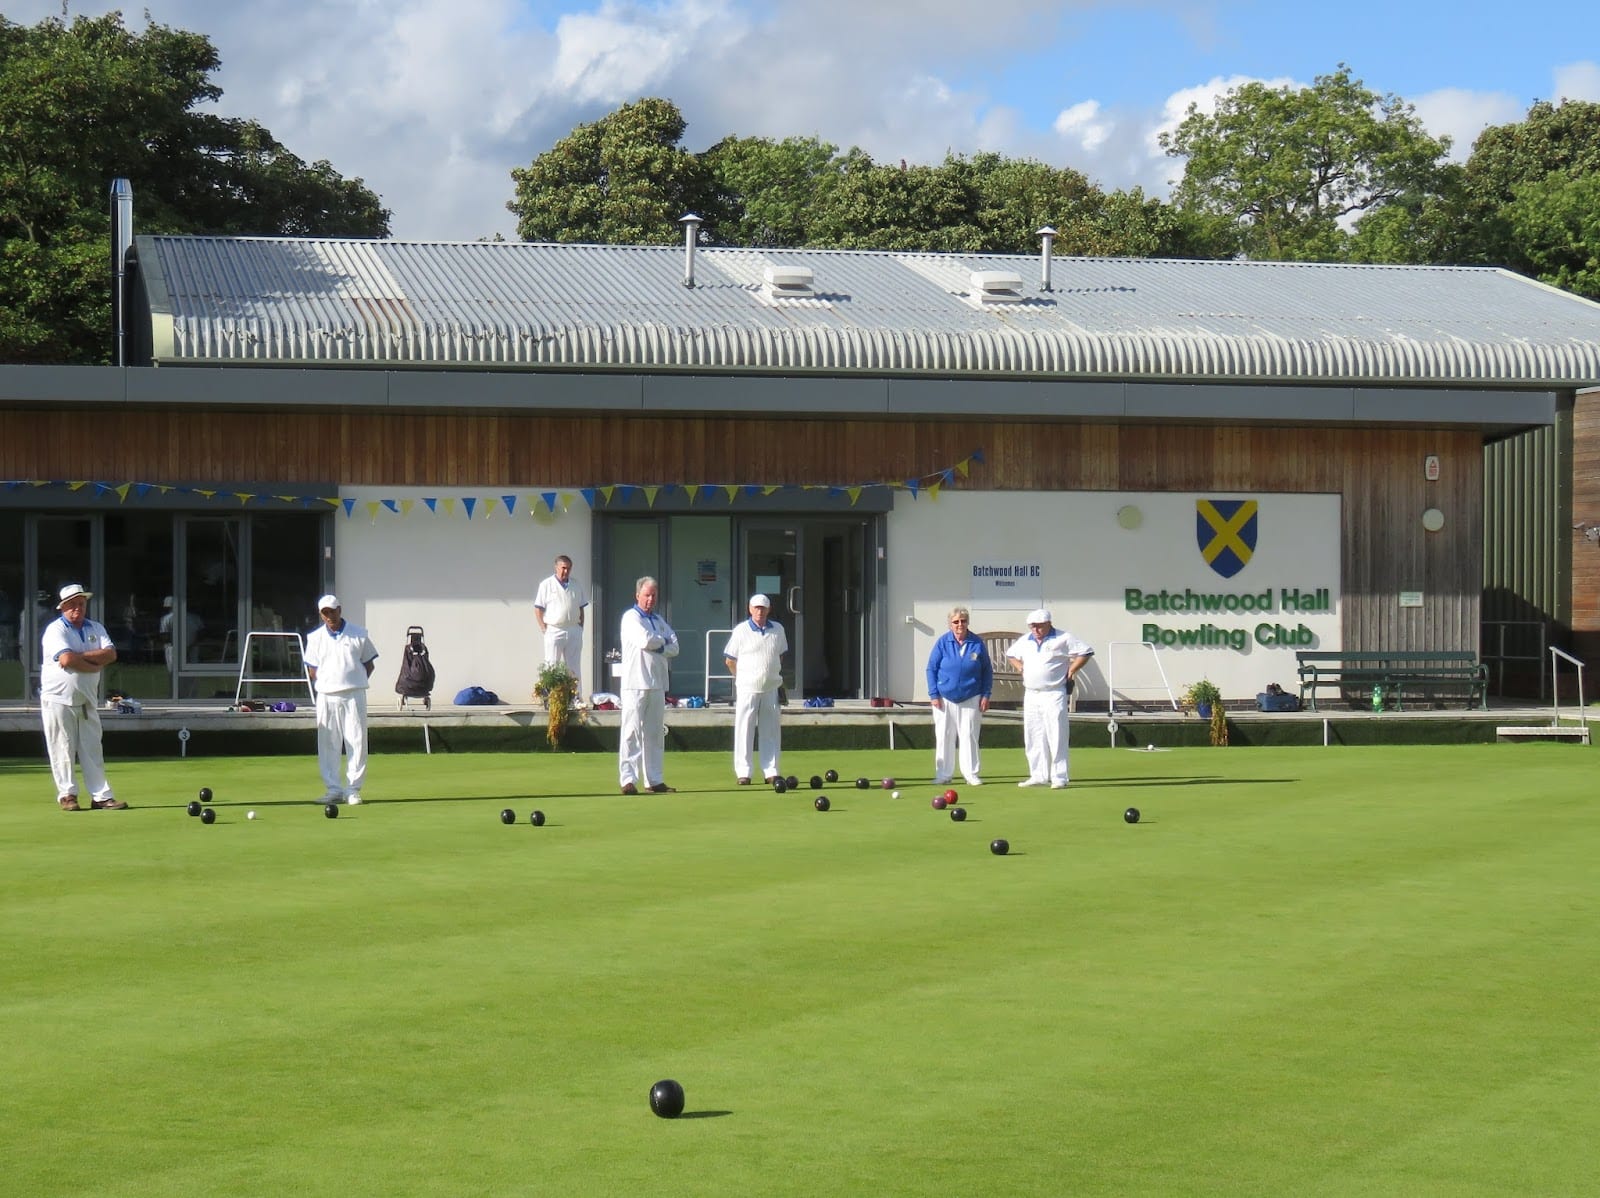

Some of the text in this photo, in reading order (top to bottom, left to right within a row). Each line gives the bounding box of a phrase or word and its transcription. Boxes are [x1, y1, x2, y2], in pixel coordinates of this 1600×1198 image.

[972, 565, 1040, 577] Batchwood Hall BC
[1125, 588, 1329, 611] Batchwood Hall
[1142, 622, 1314, 650] Bowling Club
